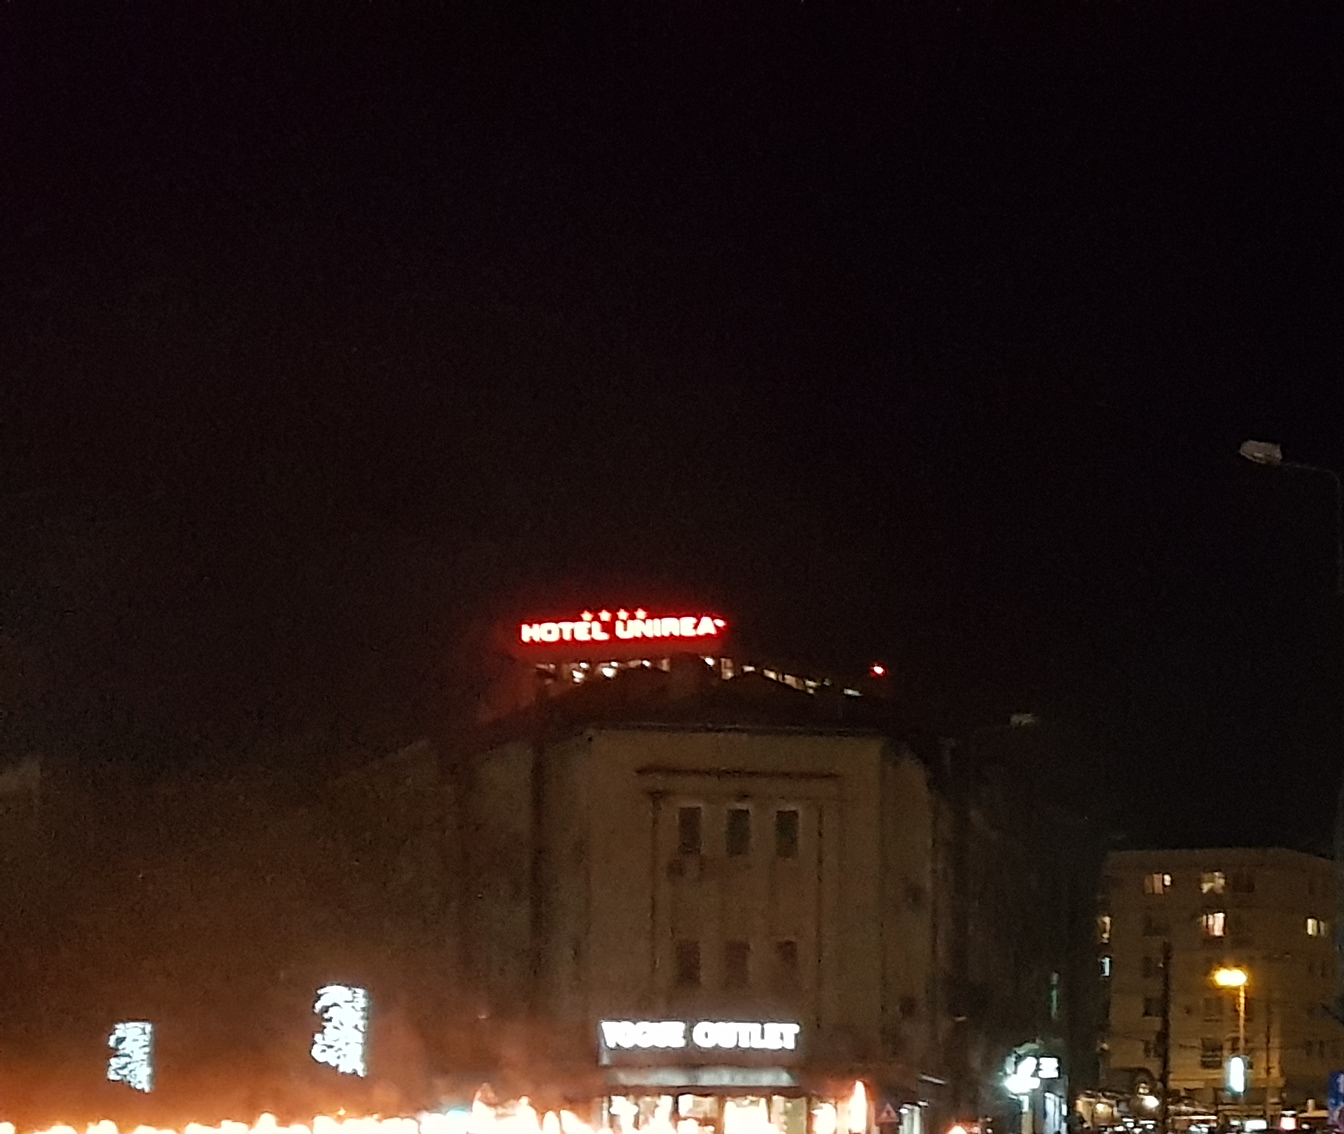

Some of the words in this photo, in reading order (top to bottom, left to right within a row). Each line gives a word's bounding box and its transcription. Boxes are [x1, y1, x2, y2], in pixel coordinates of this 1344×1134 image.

[521, 620, 609, 642] HOTEL
[615, 616, 717, 639] UNIREA
[601, 1020, 687, 1049] VOGUE
[693, 1021, 800, 1050] OUTLET
